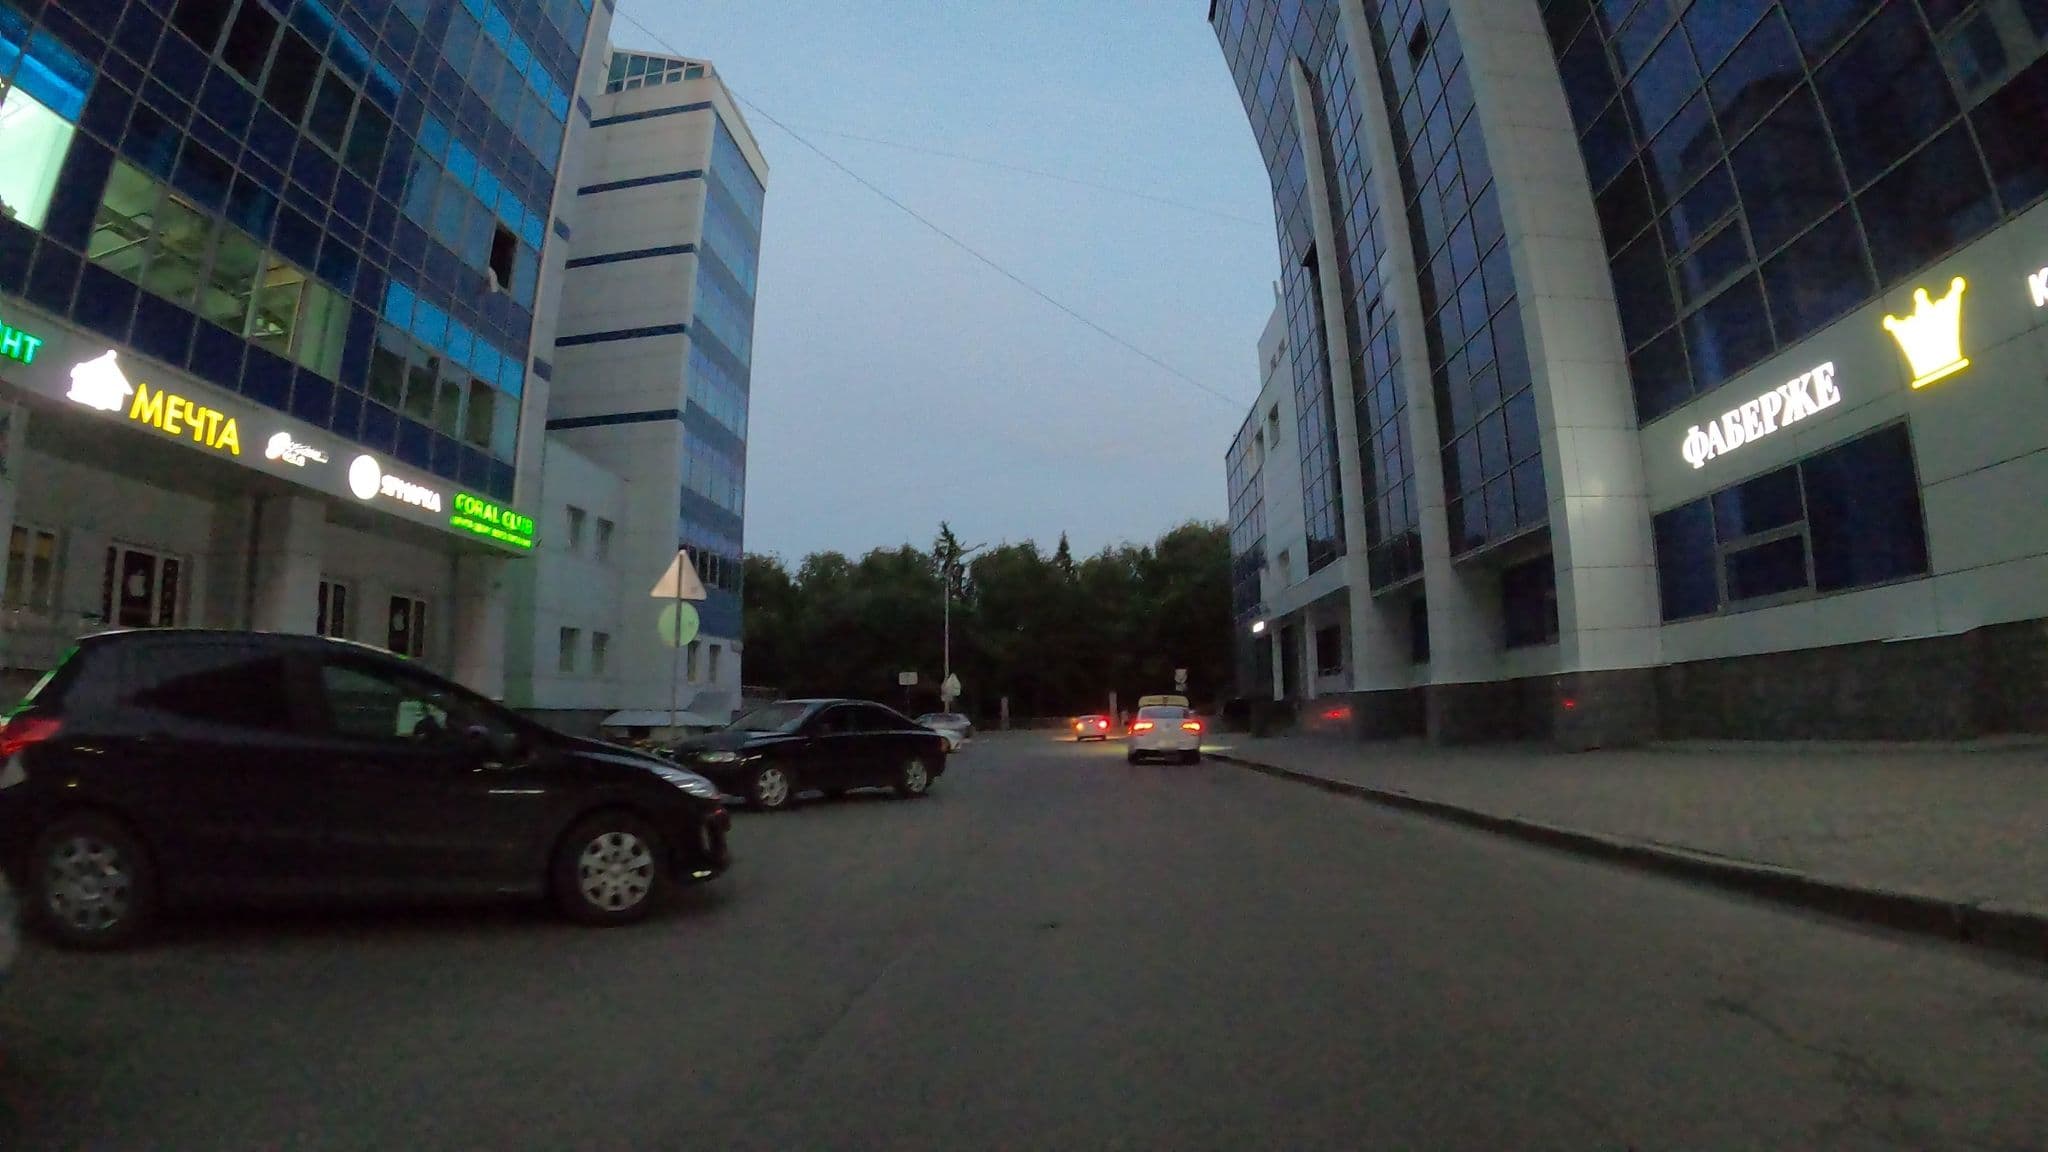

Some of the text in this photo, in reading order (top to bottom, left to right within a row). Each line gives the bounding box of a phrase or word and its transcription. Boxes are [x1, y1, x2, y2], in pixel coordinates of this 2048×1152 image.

[0, 322, 42, 363] НТ
[129, 383, 240, 455] МЕЧТА
[1682, 361, 1841, 469] ФАБЕРЖЕ
[456, 494, 500, 524] CORAL
[502, 512, 532, 535] CLUB
